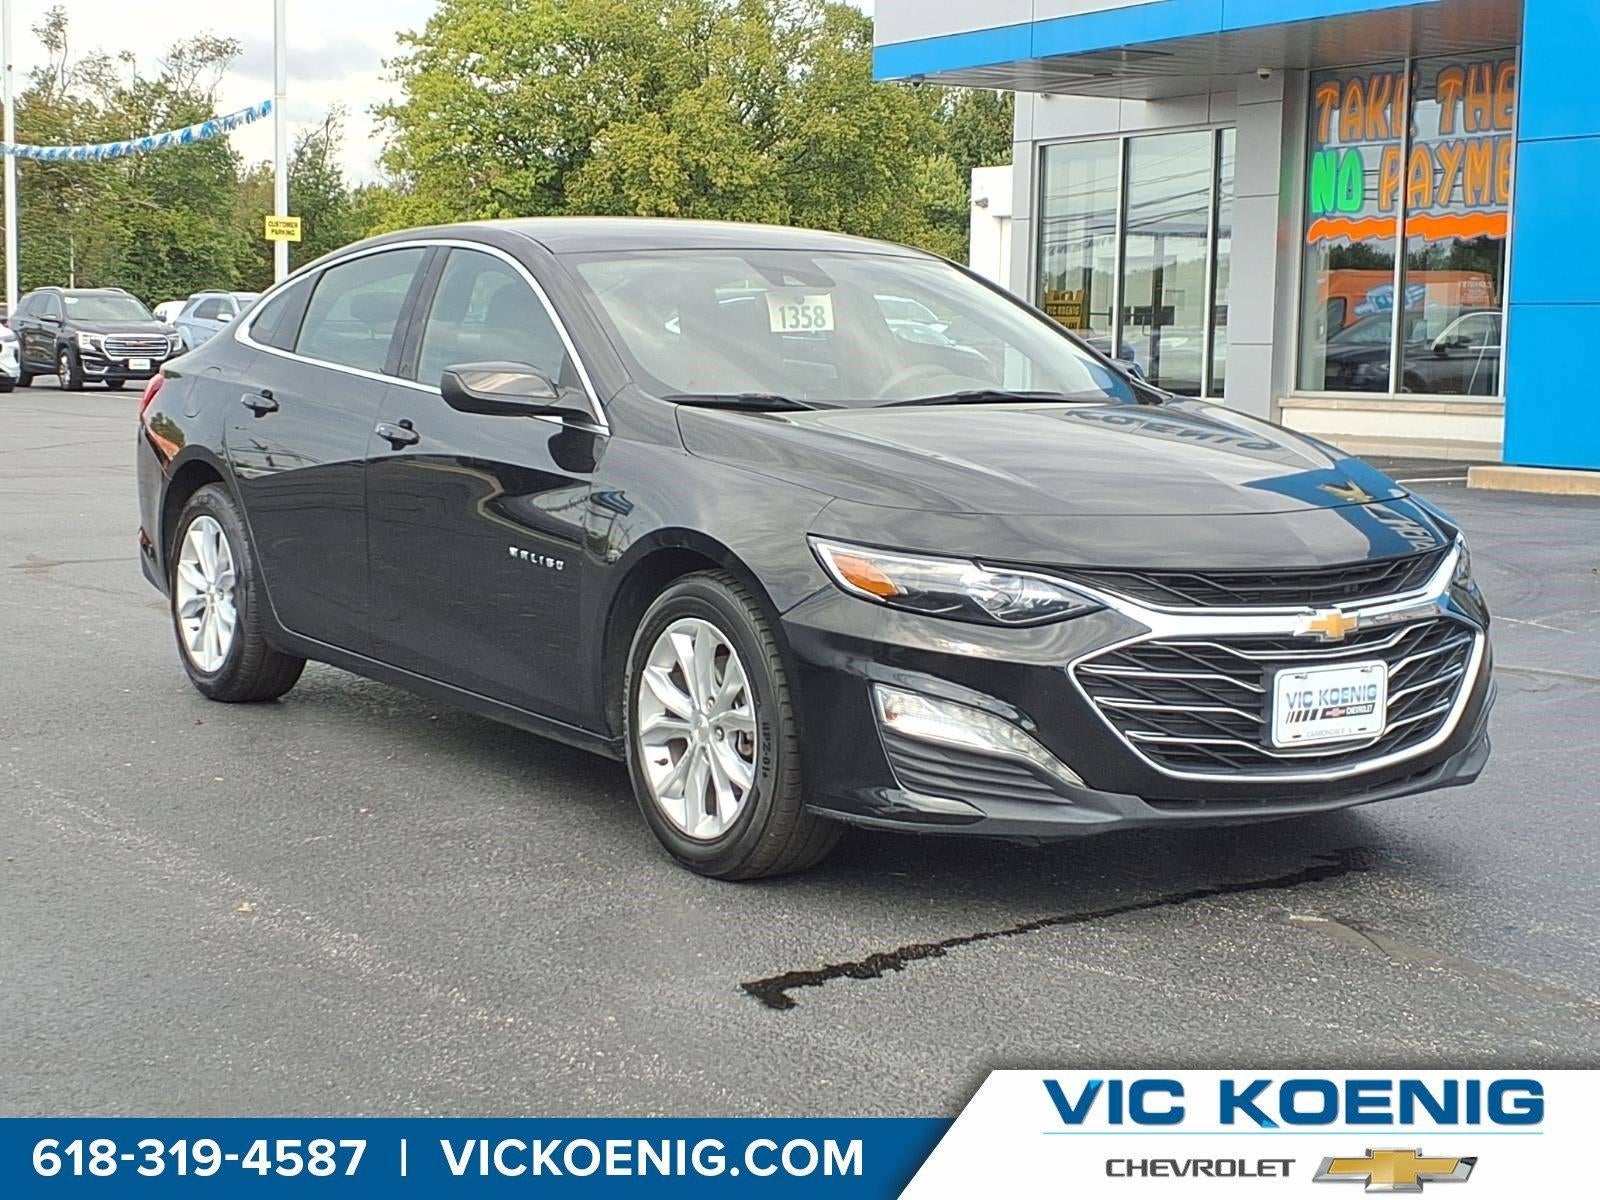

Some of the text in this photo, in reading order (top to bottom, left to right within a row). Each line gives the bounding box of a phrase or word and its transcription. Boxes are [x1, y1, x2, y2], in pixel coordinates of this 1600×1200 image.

[1313, 58, 1516, 144] TAKE THE
[1309, 146, 1365, 214] NO
[778, 305, 826, 329] 1358
[508, 546, 565, 571] MALIBU
[1286, 684, 1377, 710] VIC KOENIG
